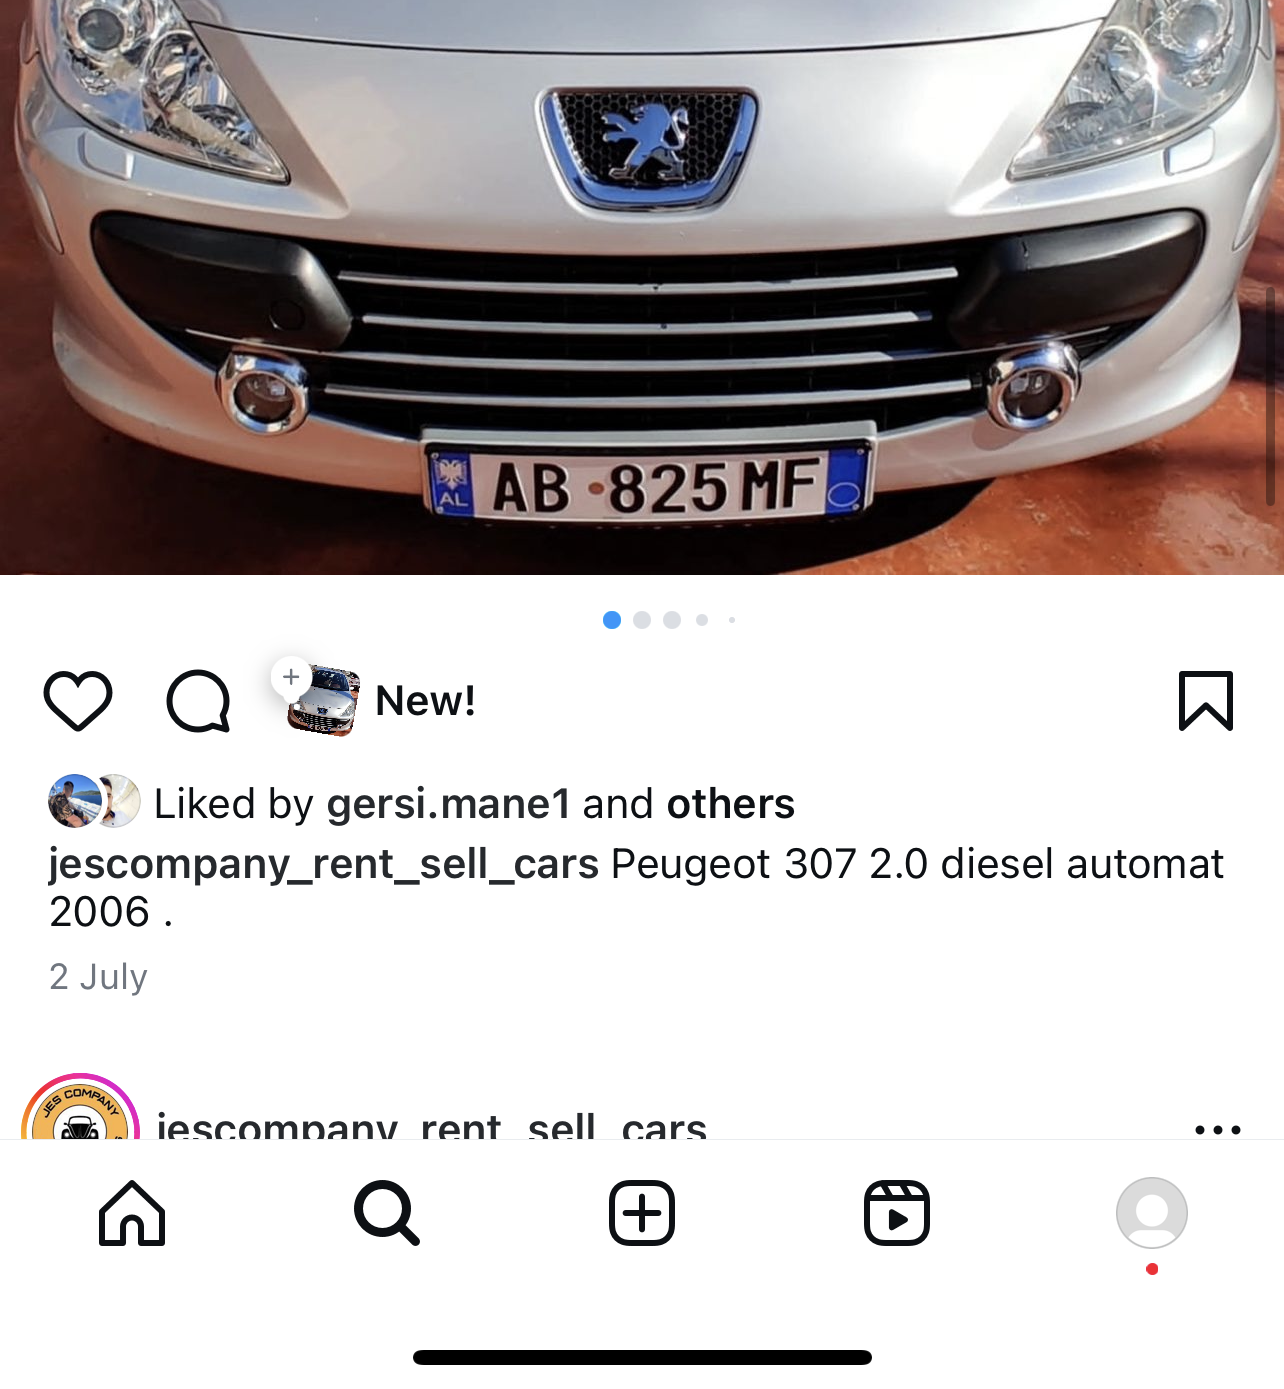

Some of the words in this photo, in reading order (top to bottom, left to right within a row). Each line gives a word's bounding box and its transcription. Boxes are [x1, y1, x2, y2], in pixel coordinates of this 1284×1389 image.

[440, 494, 469, 508] AL
[493, 463, 569, 512] AB
[609, 463, 727, 513] 825
[741, 457, 820, 510] MF
[377, 685, 474, 716] New!
[157, 787, 254, 819] Liked
[270, 787, 313, 826] by
[328, 786, 567, 826] gersi.mane1
[584, 787, 652, 819] and
[668, 787, 794, 819] others
[48, 846, 598, 886] jescompany_rent_sell_cars
[614, 848, 770, 886] Peugeot
[786, 848, 856, 879] 307
[871, 847, 927, 879] 2.0
[942, 847, 1051, 879] diesel
[1068, 850, 1224, 879] automat
[51, 895, 148, 927] 2006
[51, 963, 67, 989] 2
[81, 962, 147, 996] July
[43, 1095, 62, 1118] JES
[64, 1088, 120, 1116] COMPANY
[159, 1112, 706, 1139] jescompanyrentsellcars
